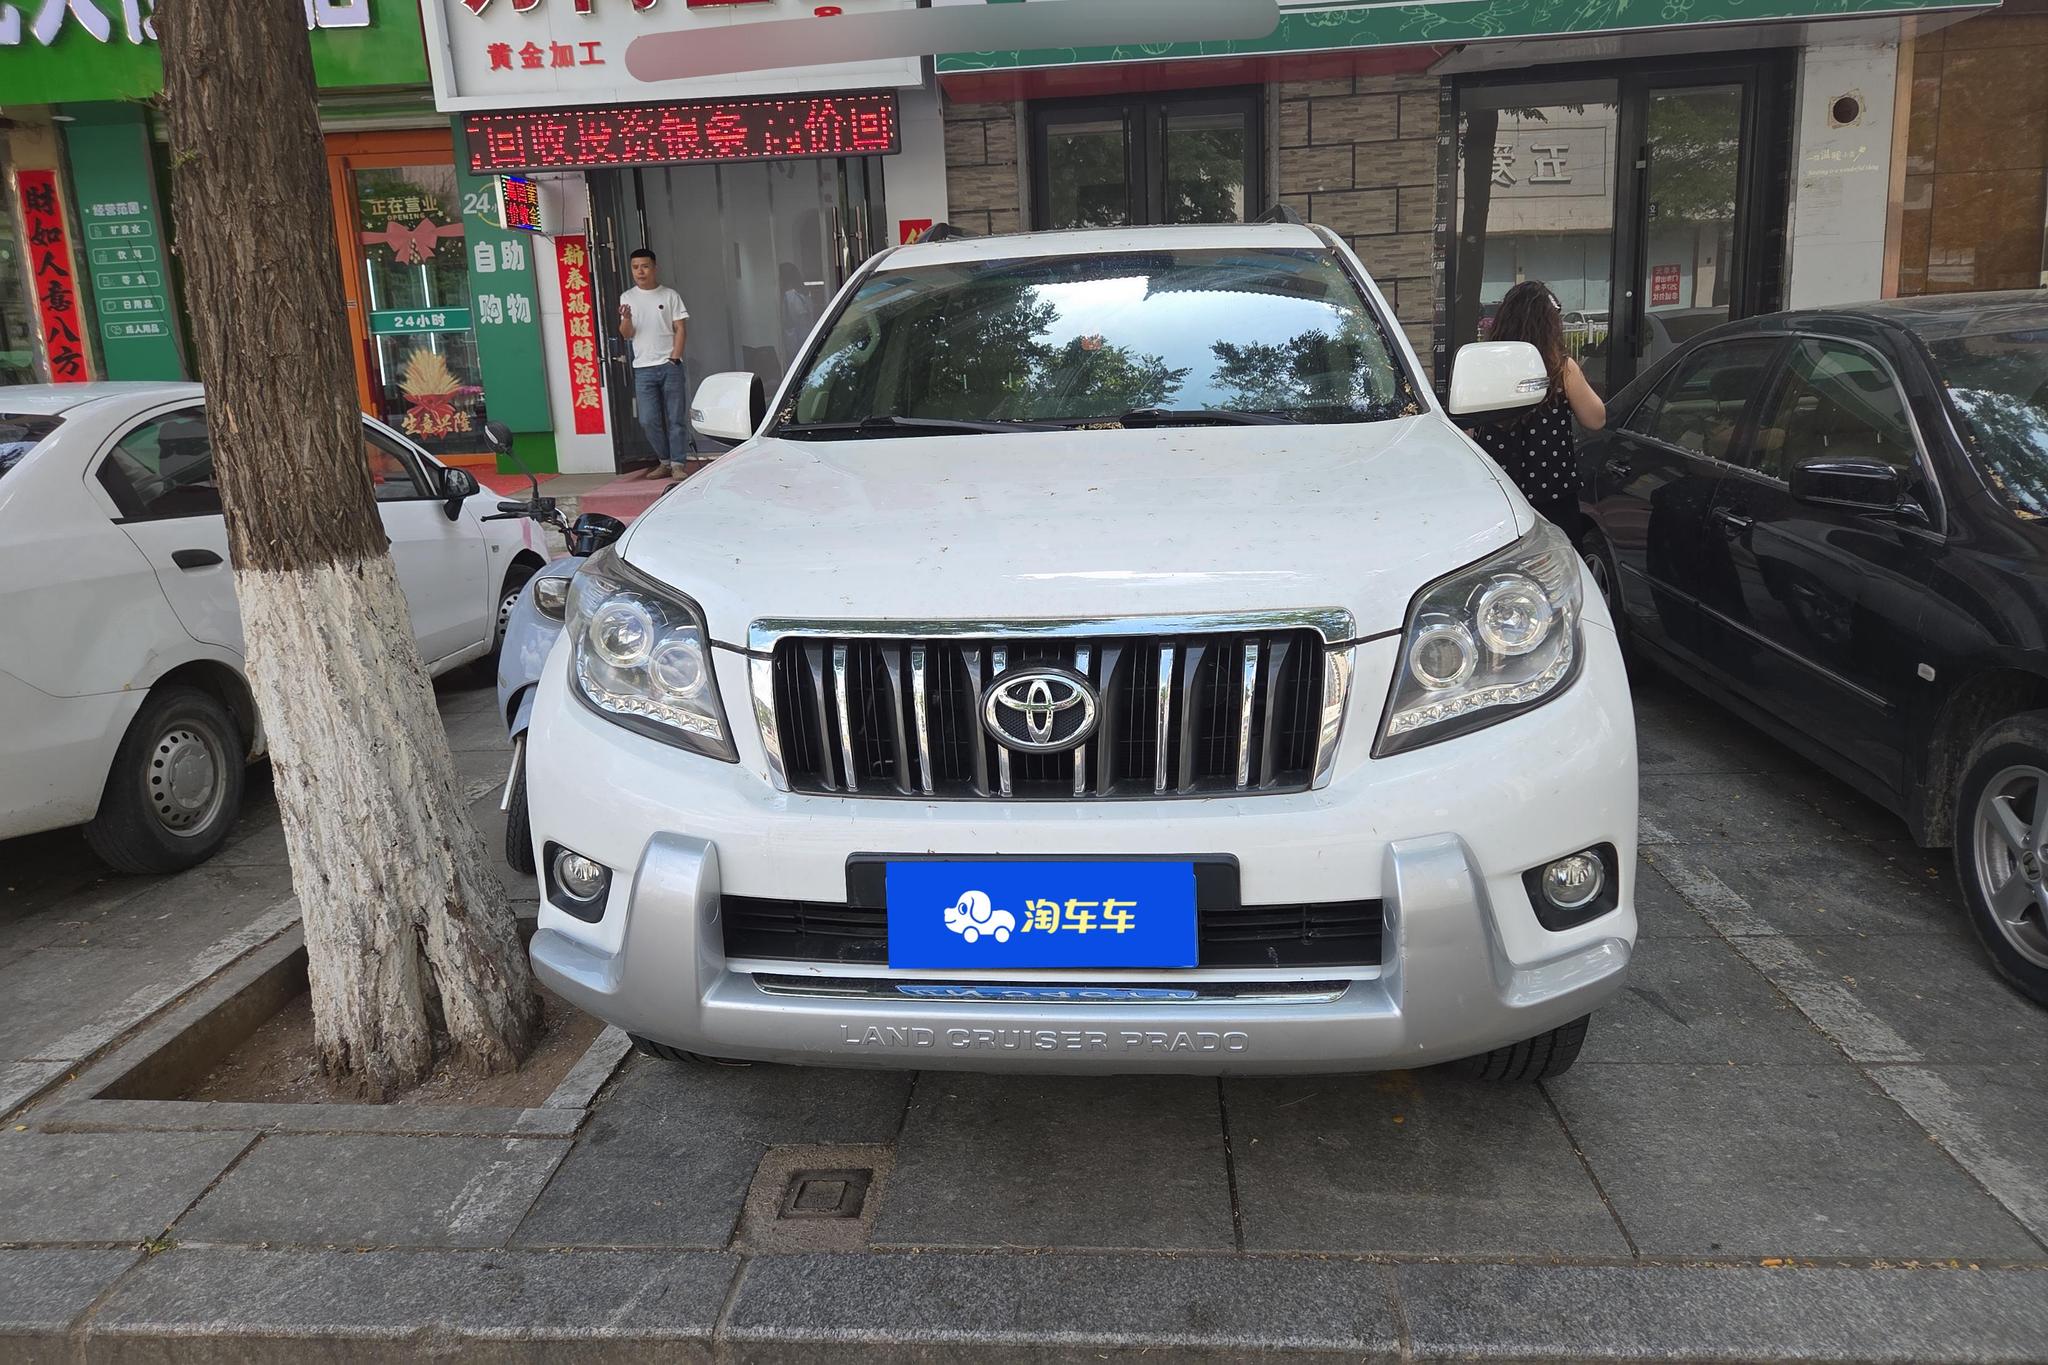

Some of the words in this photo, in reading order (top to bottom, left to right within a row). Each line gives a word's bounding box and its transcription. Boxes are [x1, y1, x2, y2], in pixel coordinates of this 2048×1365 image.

[486, 40, 606, 71] 黄金加工
[93, 202, 140, 217] 经营范围
[371, 195, 439, 216] 正在营业
[386, 213, 426, 221] OPENING
[474, 240, 524, 273] 自助
[123, 299, 153, 309] 日用品
[479, 291, 531, 325] 购物
[126, 323, 159, 334] 成人用品
[394, 313, 446, 329] 24小时
[401, 412, 472, 436] 生意兴隆
[841, 1024, 936, 1049] LAND
[946, 1028, 1109, 1052] CRUISER
[1120, 1031, 1250, 1053] PRADO
